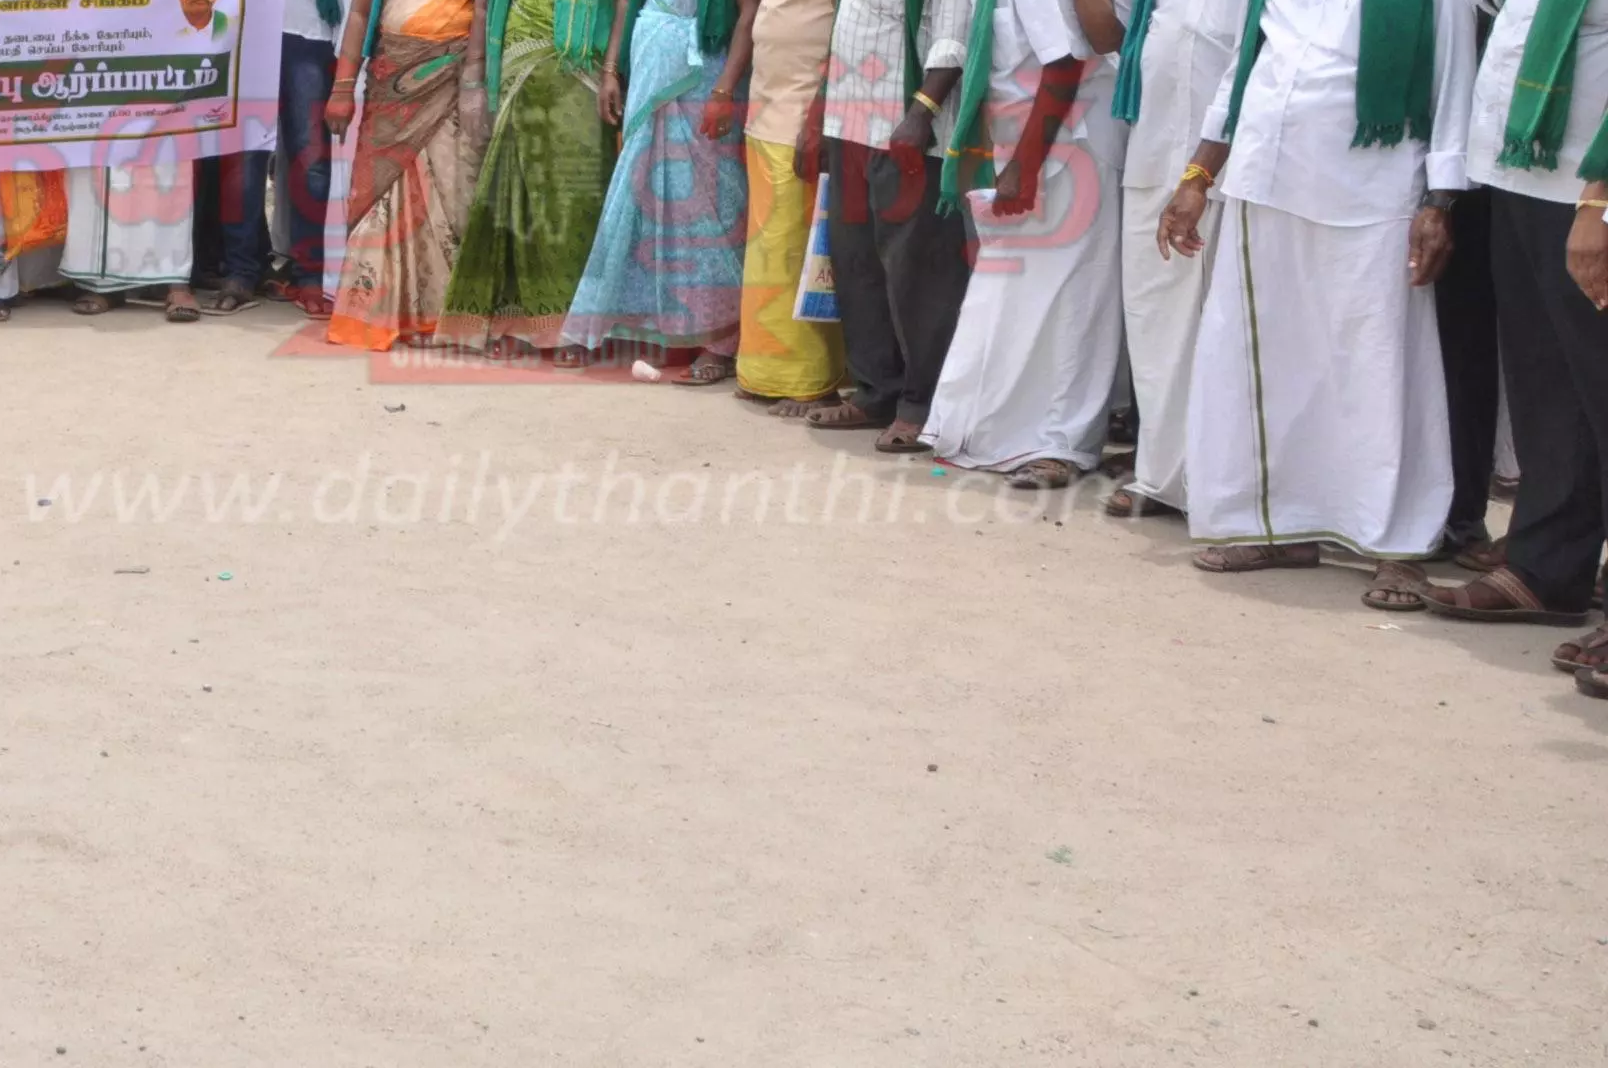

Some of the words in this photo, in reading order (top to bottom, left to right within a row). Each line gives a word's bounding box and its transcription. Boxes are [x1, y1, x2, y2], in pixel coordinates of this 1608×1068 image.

[3, 33, 55, 45] தடையை
[61, 30, 90, 43] நீக்க
[27, 43, 65, 56] செய்ய
[71, 41, 124, 54] கோரியும்
[32, 57, 219, 103] ஆர்ப்பாட்டம்
